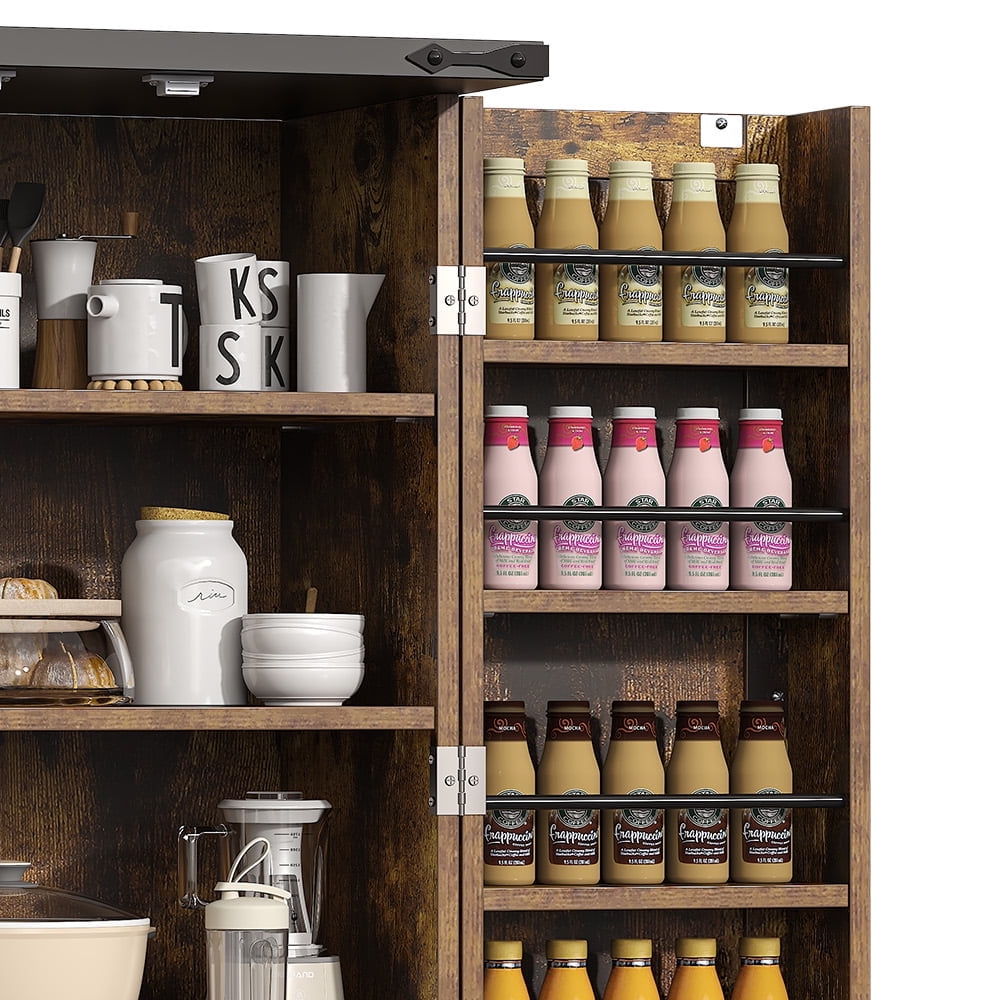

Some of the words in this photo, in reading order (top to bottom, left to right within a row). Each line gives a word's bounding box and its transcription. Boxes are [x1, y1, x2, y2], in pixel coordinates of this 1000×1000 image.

[230, 266, 256, 320] K
[258, 267, 278, 321] S
[160, 293, 182, 367] T
[216, 331, 240, 385] S
[265, 335, 285, 388] K
